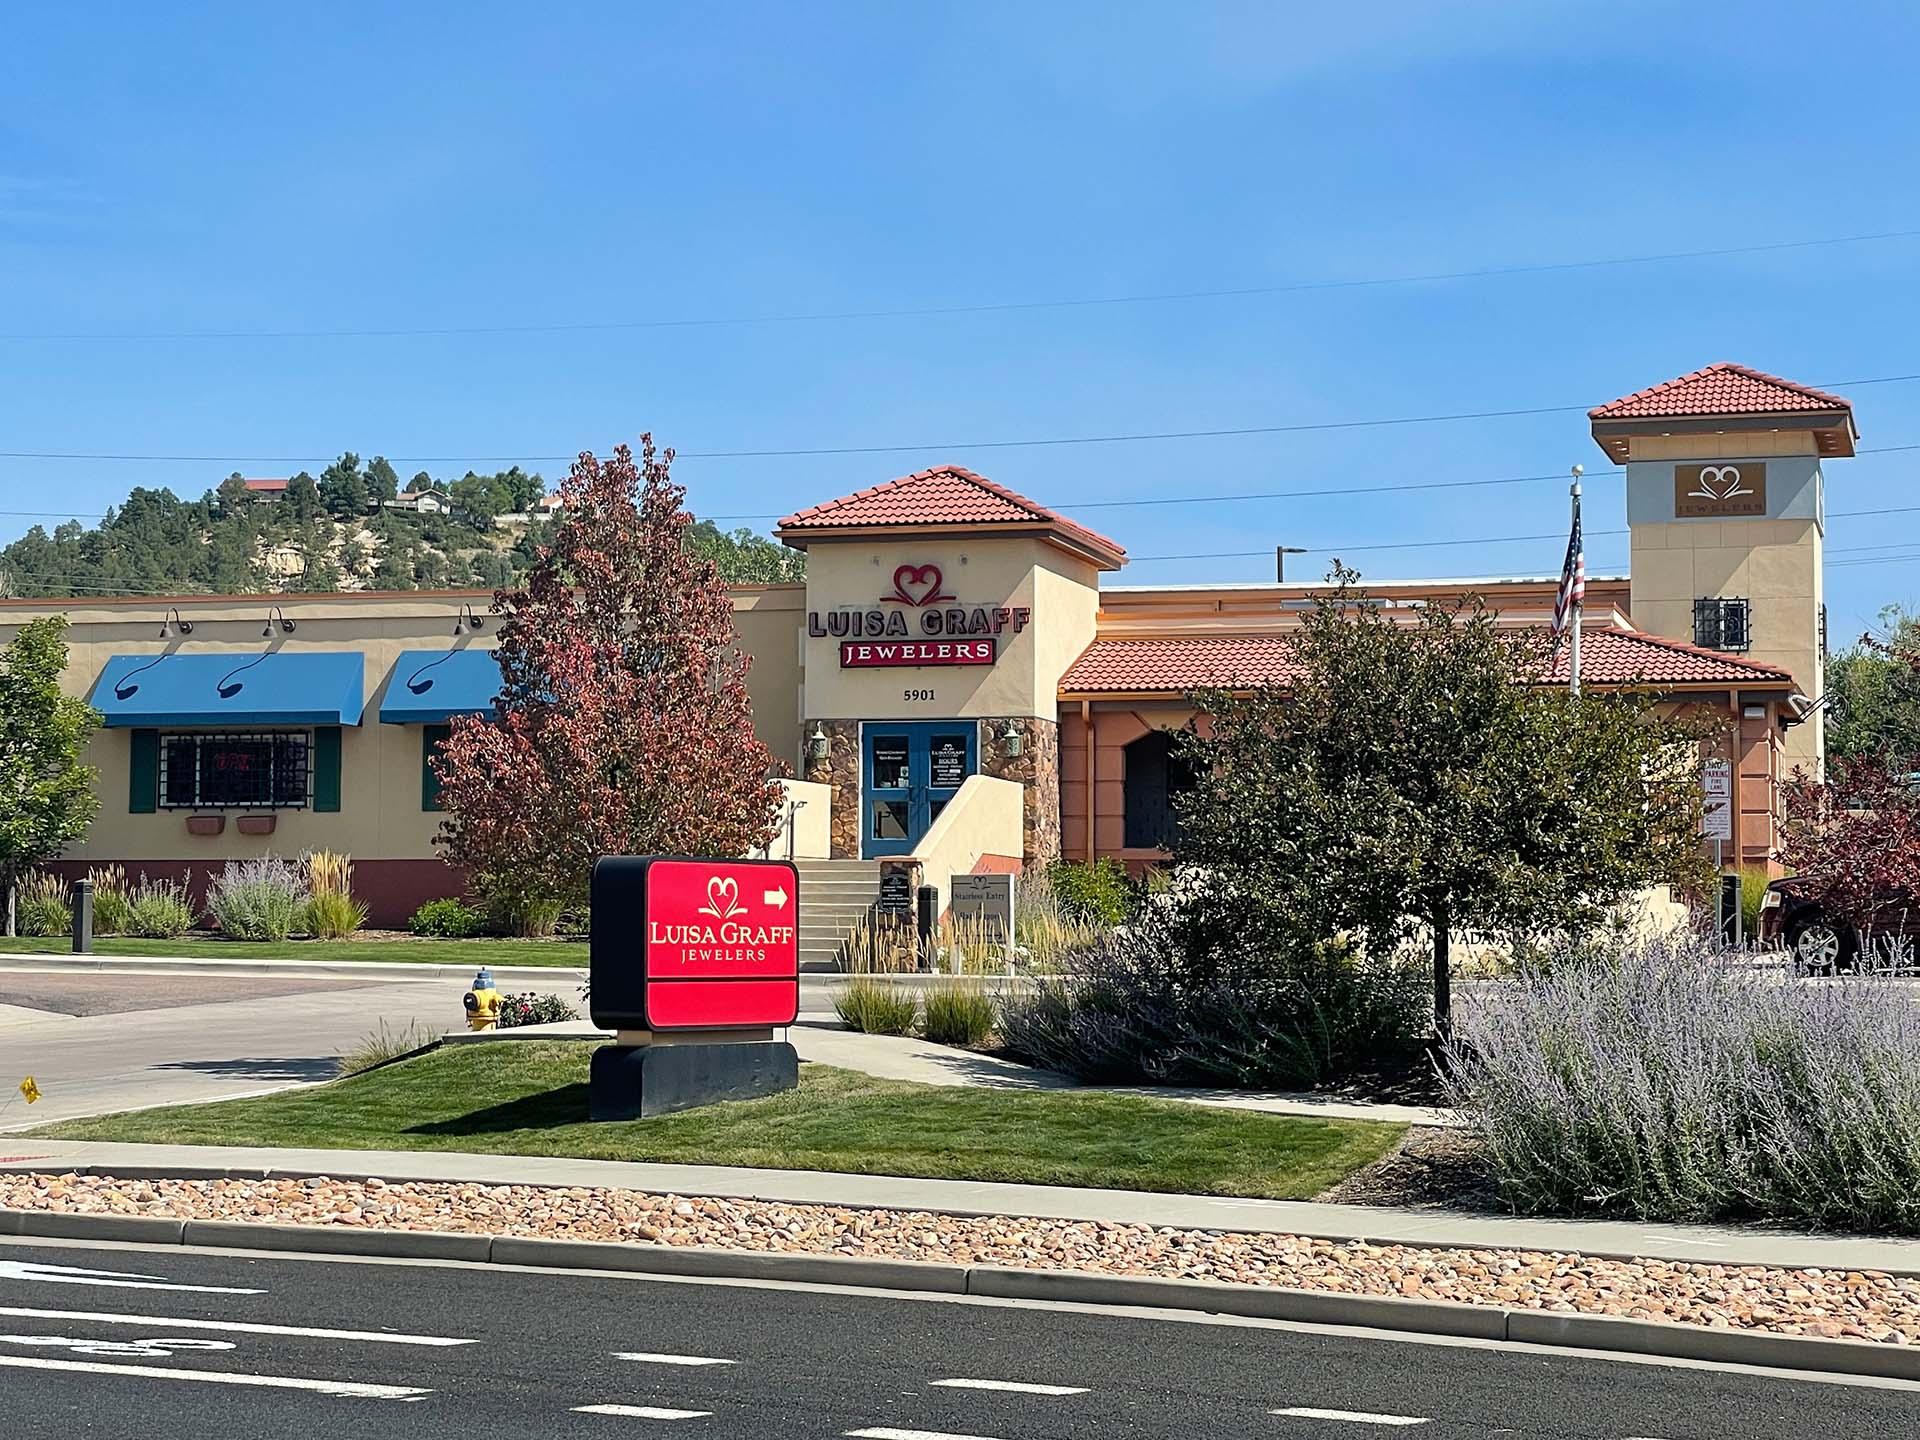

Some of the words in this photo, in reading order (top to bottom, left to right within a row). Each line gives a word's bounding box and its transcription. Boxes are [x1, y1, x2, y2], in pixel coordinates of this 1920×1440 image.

[808, 611, 908, 637] LUISA
[921, 608, 1030, 635] GRAFF
[846, 643, 989, 664] JEWELERS
[903, 689, 936, 701] 5901
[986, 892, 1005, 902] Entry
[650, 922, 716, 944] LUISA
[720, 922, 793, 946] GRAFF
[681, 949, 765, 964] JEWELERS
